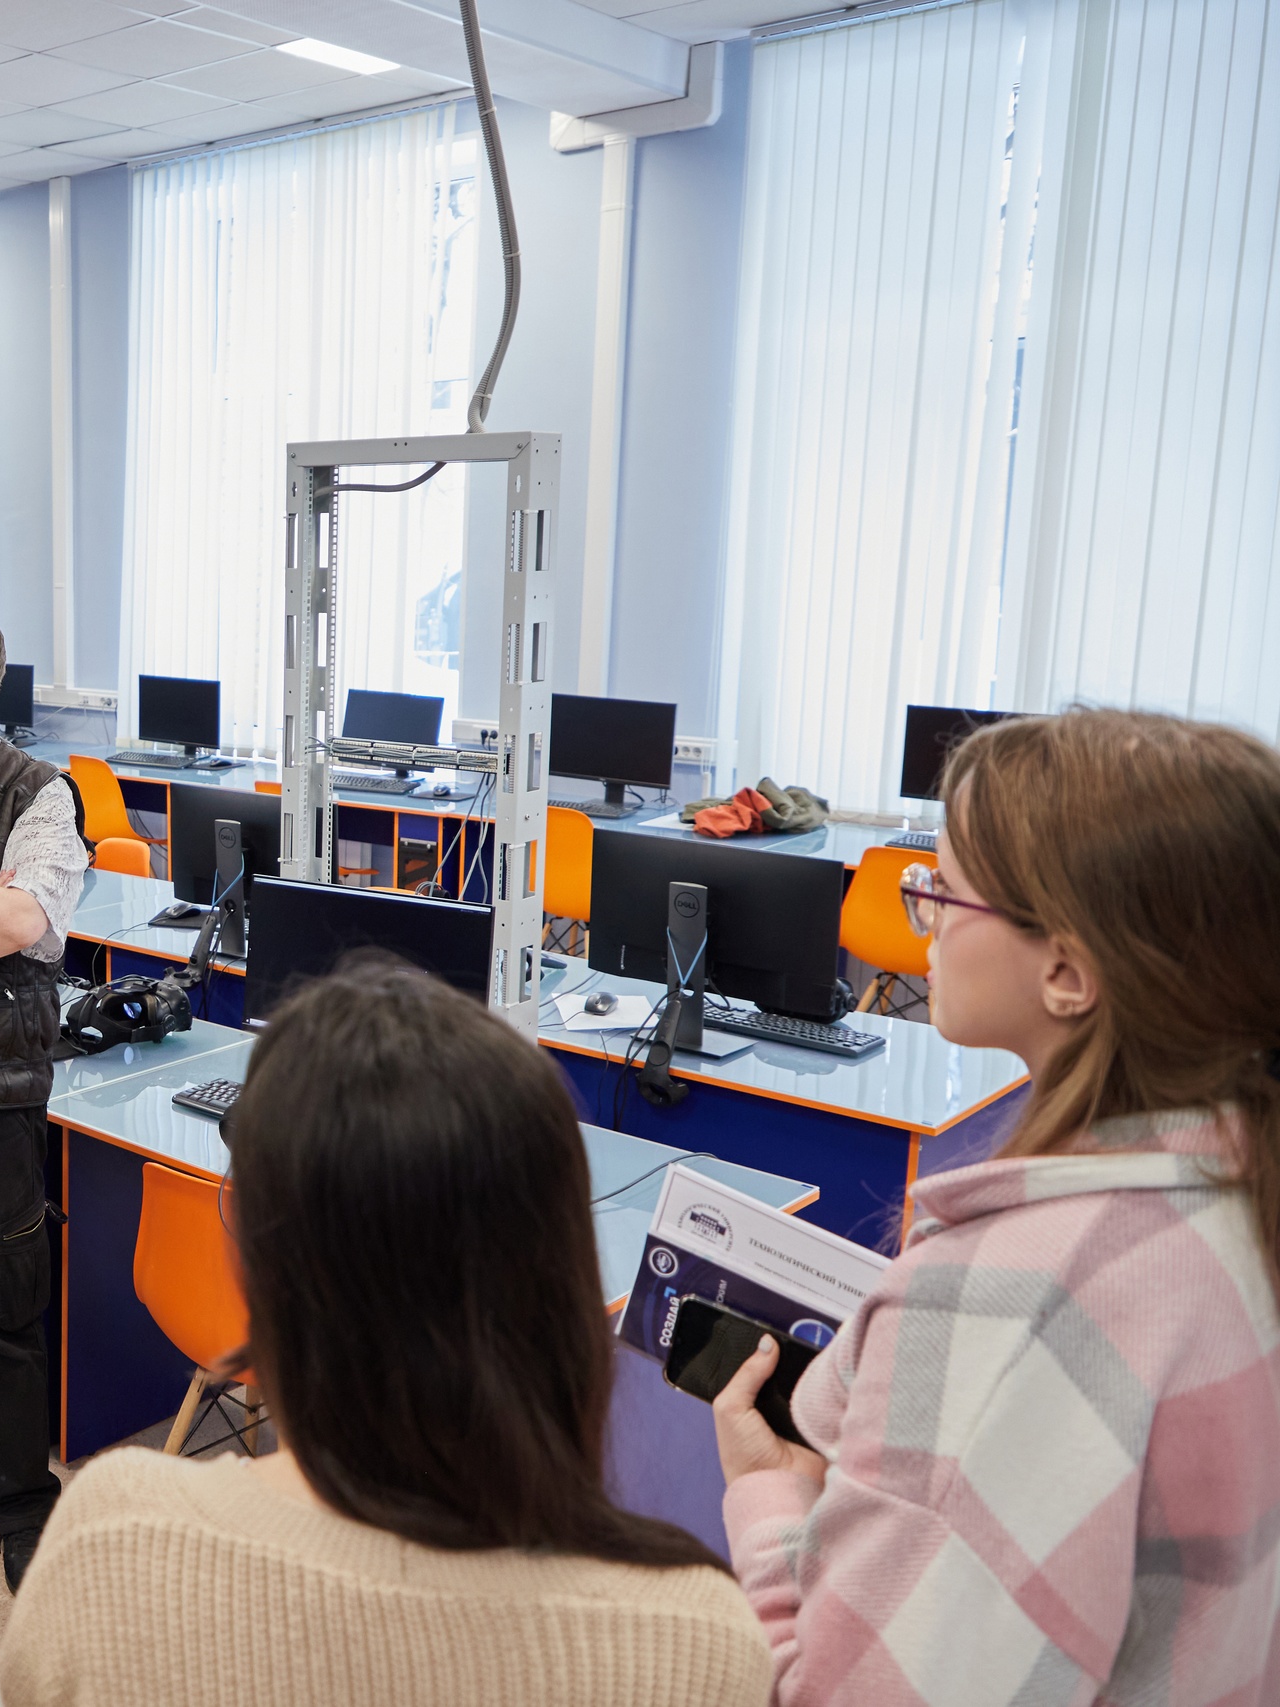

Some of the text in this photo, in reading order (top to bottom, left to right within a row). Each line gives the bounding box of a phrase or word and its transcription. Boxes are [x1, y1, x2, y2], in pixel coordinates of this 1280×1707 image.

[677, 900, 696, 910] DELL
[748, 1237, 837, 1285] ТЕХНОЛОГИЧЕСКИЙ
[659, 1296, 681, 1347] СОЗДАЙ
